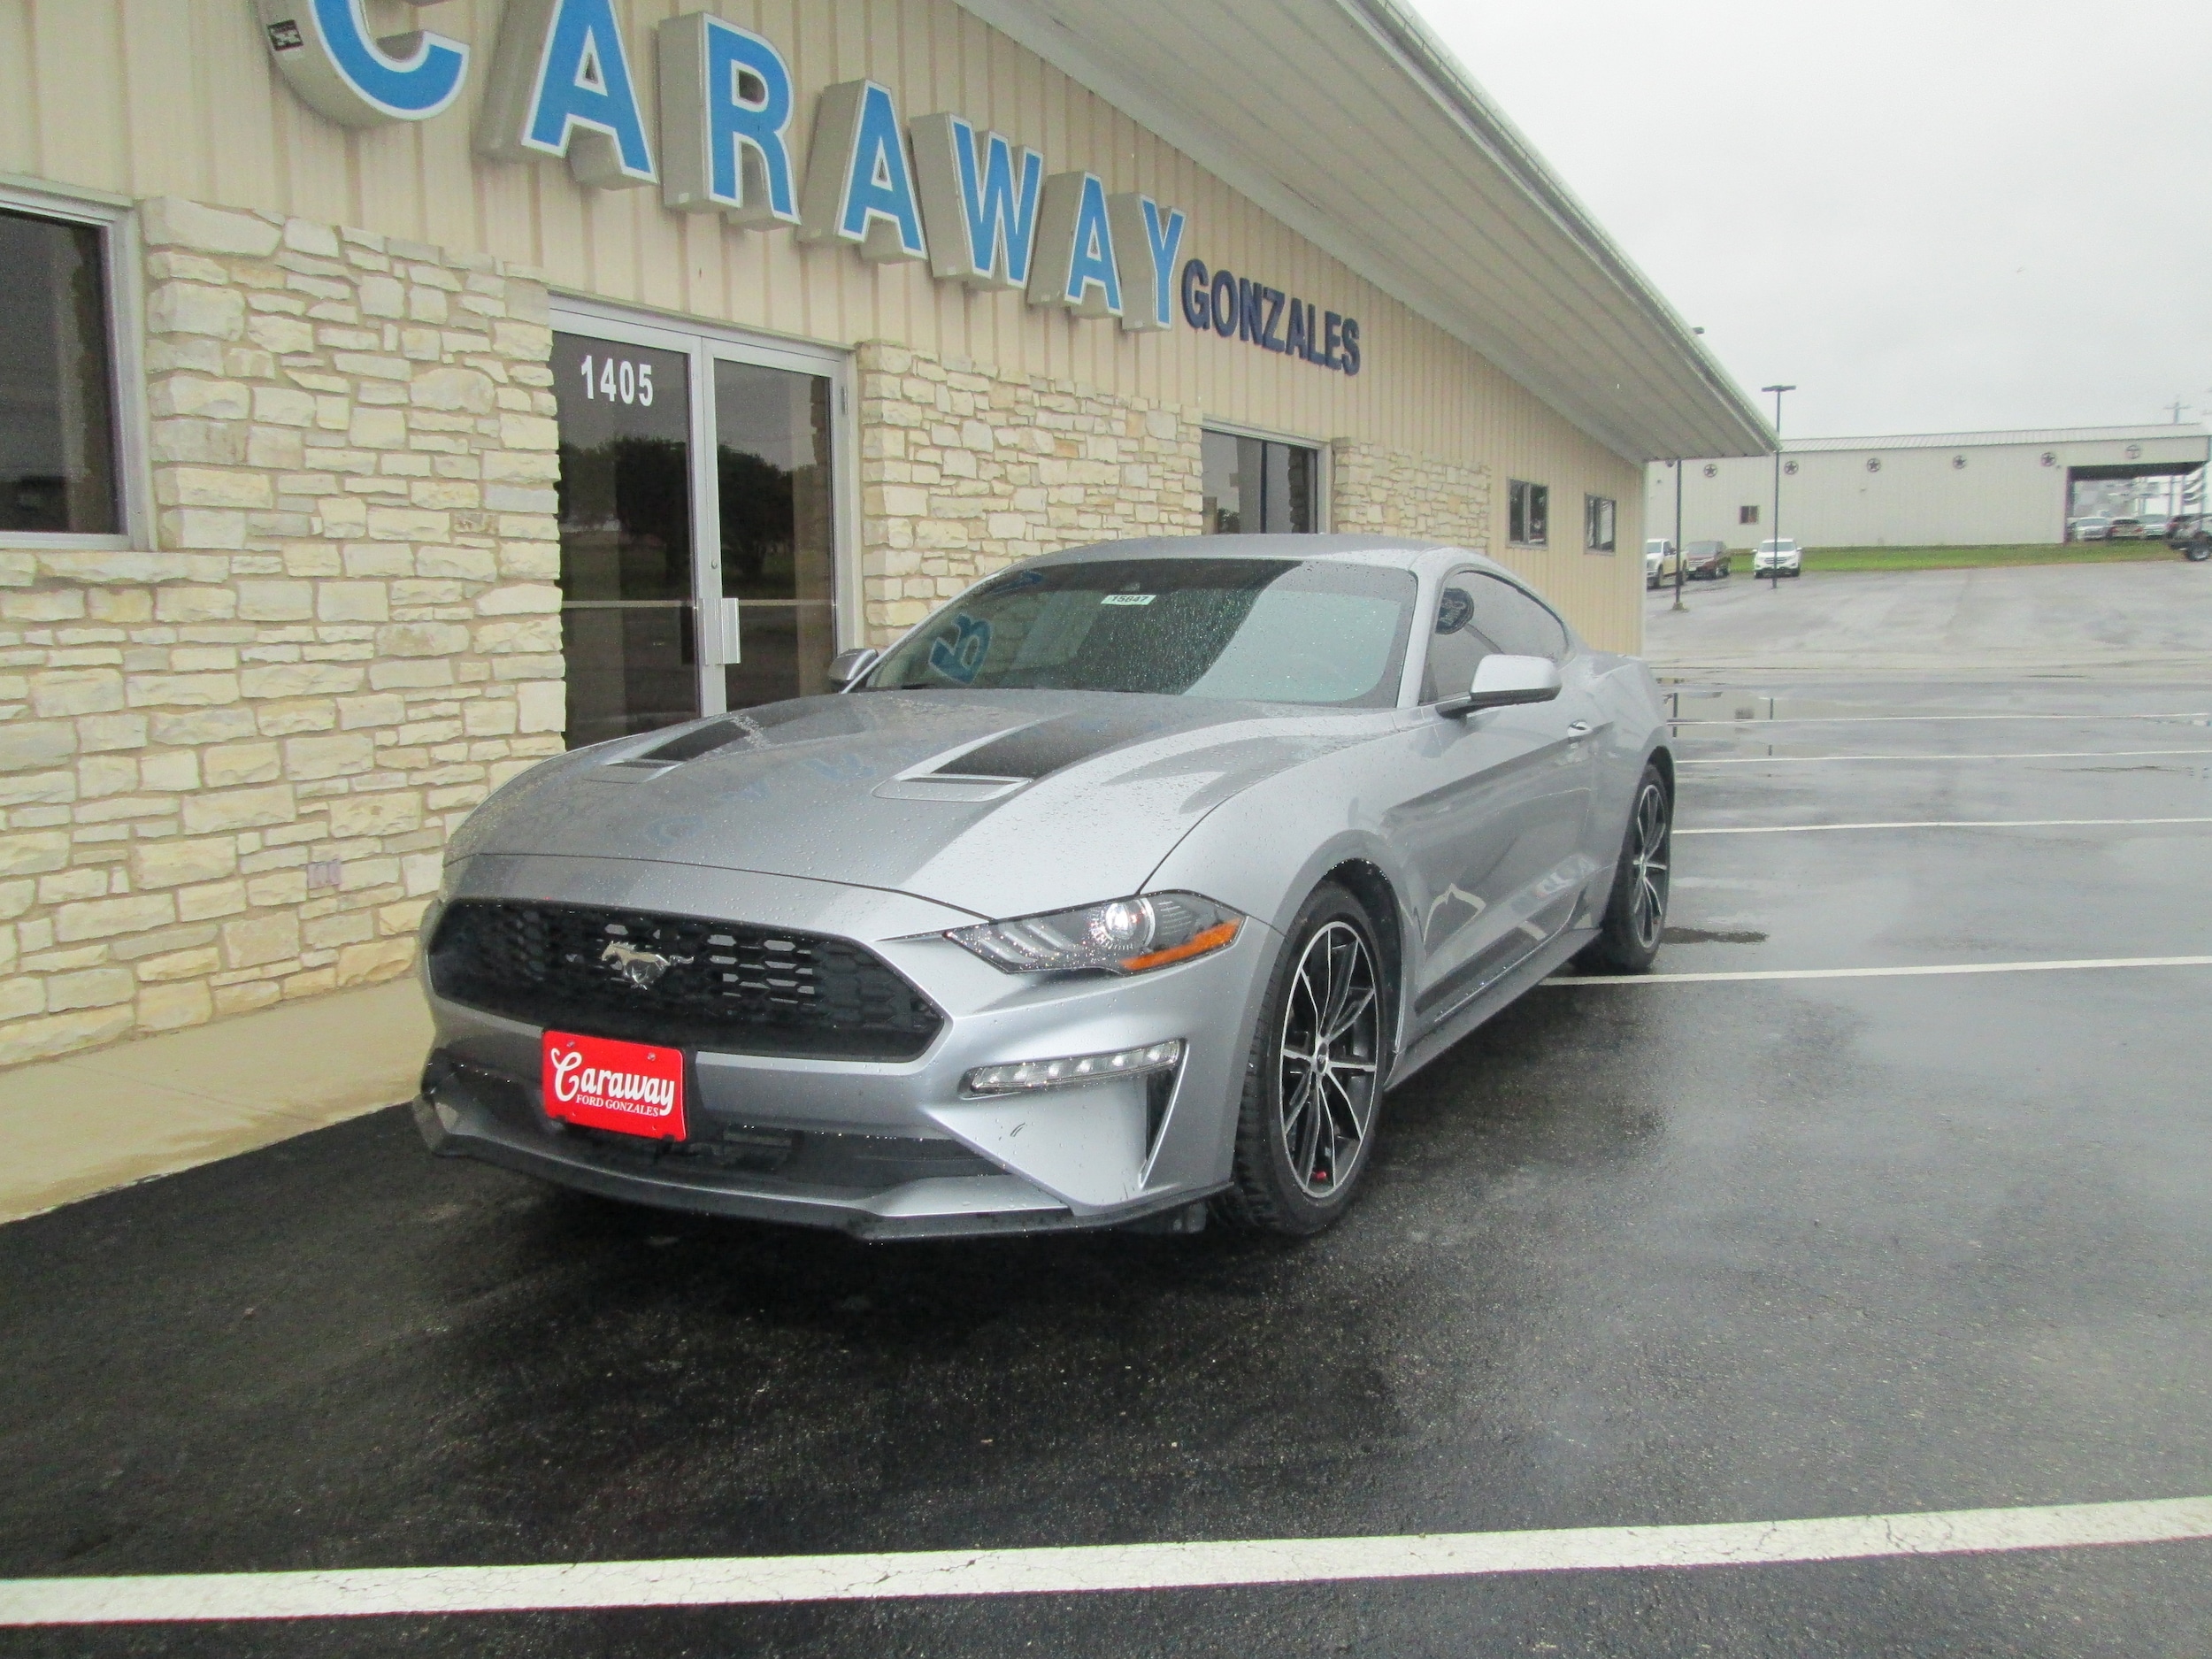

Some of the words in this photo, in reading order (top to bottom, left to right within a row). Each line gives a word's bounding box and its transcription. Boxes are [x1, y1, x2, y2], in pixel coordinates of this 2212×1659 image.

[1182, 258, 1360, 376] GONZALES
[580, 355, 654, 407] 1405
[550, 1048, 675, 1117] Caraway
[576, 1094, 604, 1108] FORD
[605, 1100, 659, 1118] GONZALES
